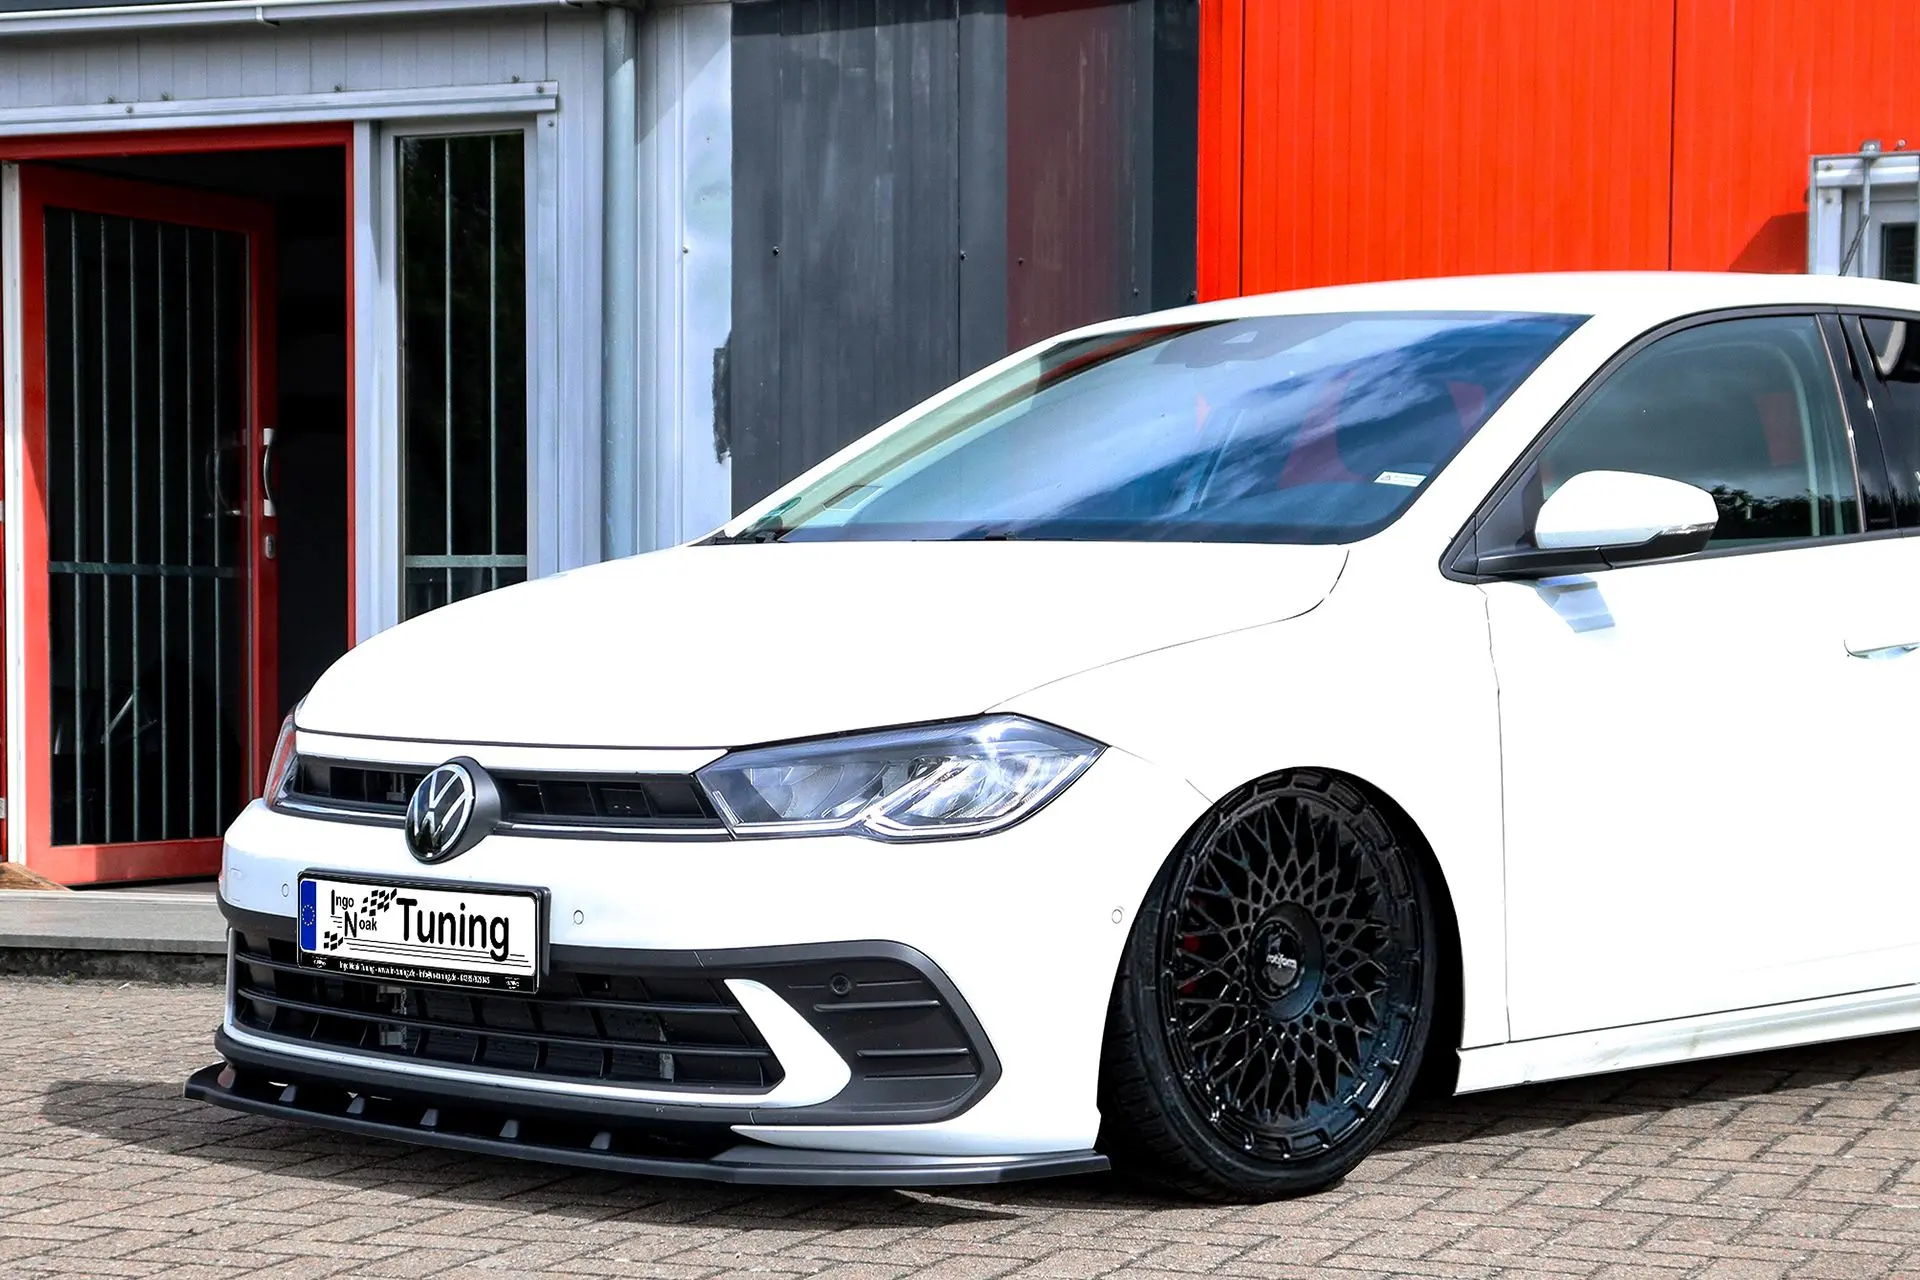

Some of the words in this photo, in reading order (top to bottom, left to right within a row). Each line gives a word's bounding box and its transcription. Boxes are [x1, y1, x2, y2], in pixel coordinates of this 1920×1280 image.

[331, 889, 355, 916] Ingo
[344, 911, 378, 938] Noak
[396, 897, 510, 962] Tuning
